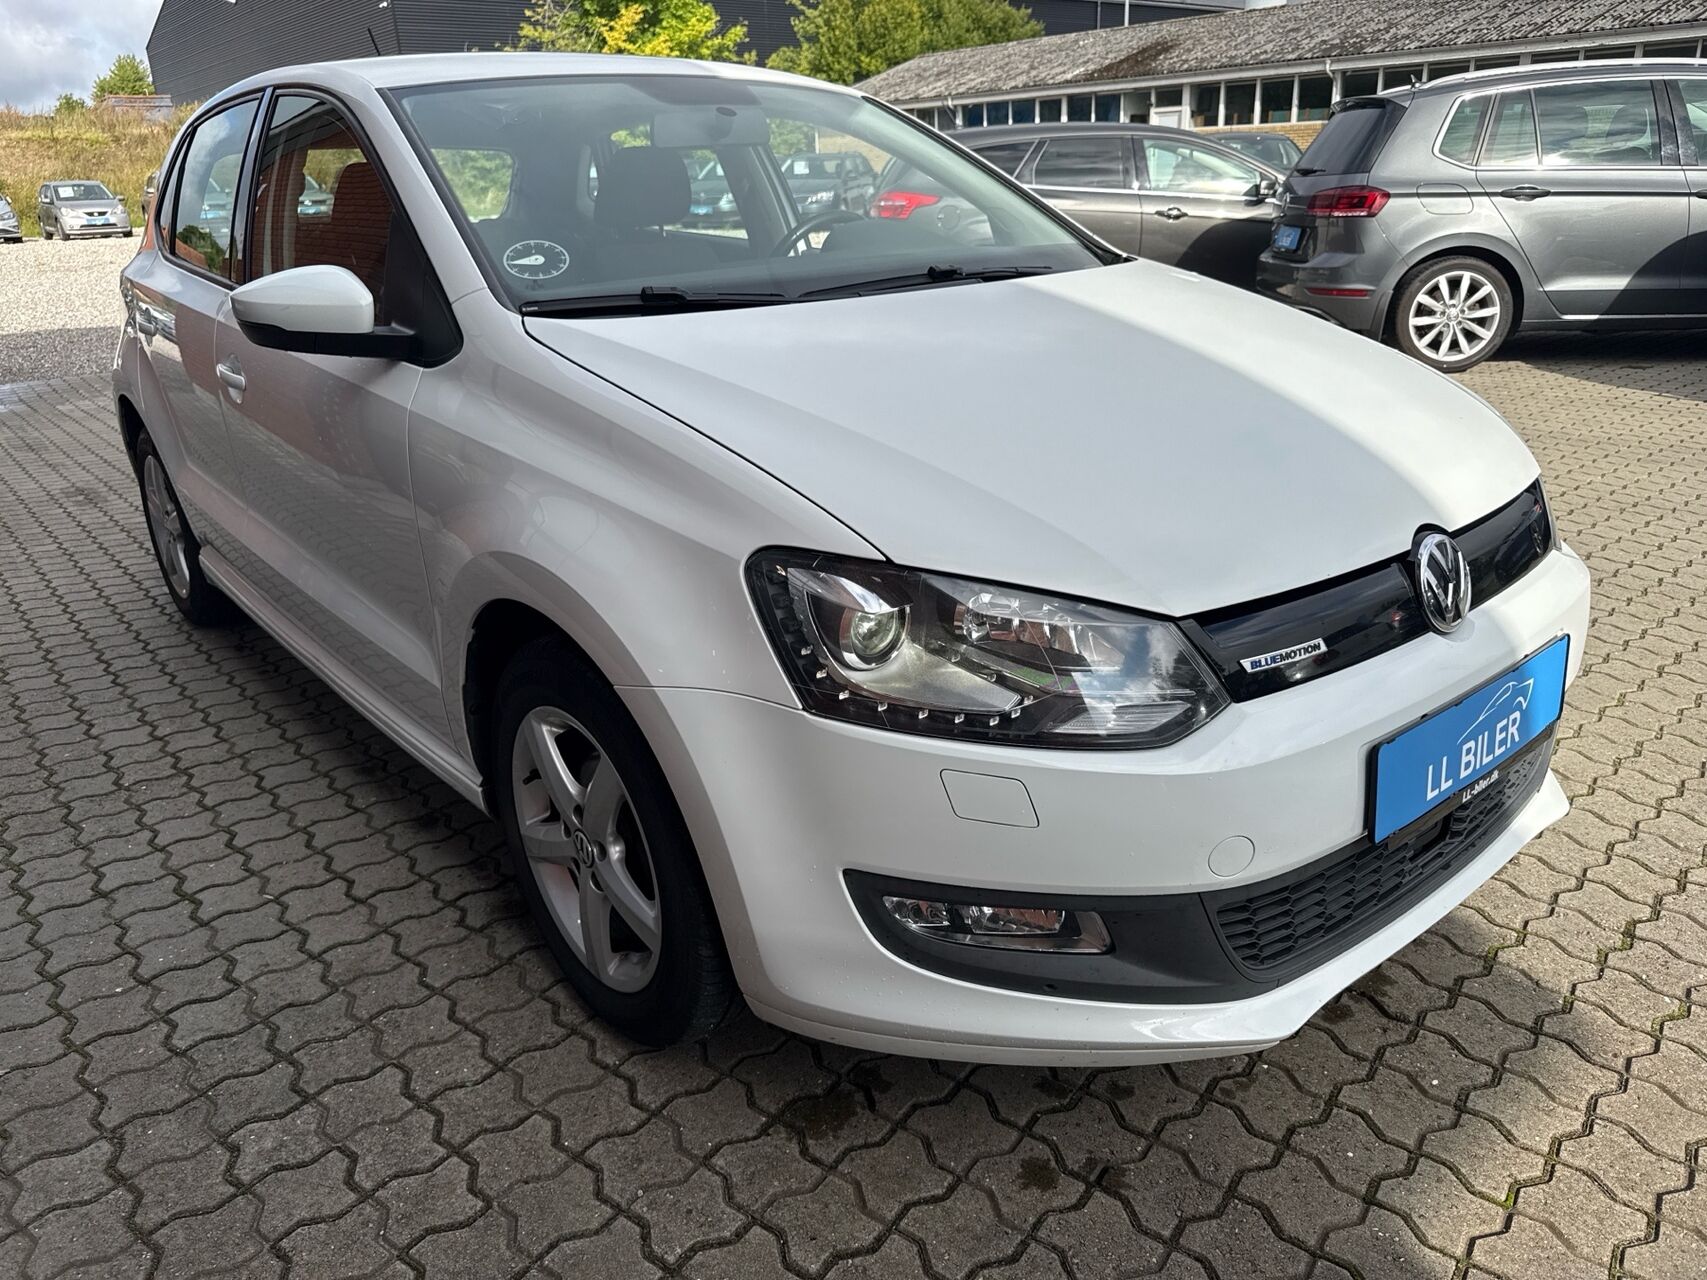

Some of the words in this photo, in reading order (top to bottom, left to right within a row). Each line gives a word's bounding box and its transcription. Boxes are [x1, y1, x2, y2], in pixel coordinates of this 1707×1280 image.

[1250, 642, 1322, 670] BLUEMOTION
[1426, 755, 1454, 801] LL
[1459, 710, 1522, 780] BILER
